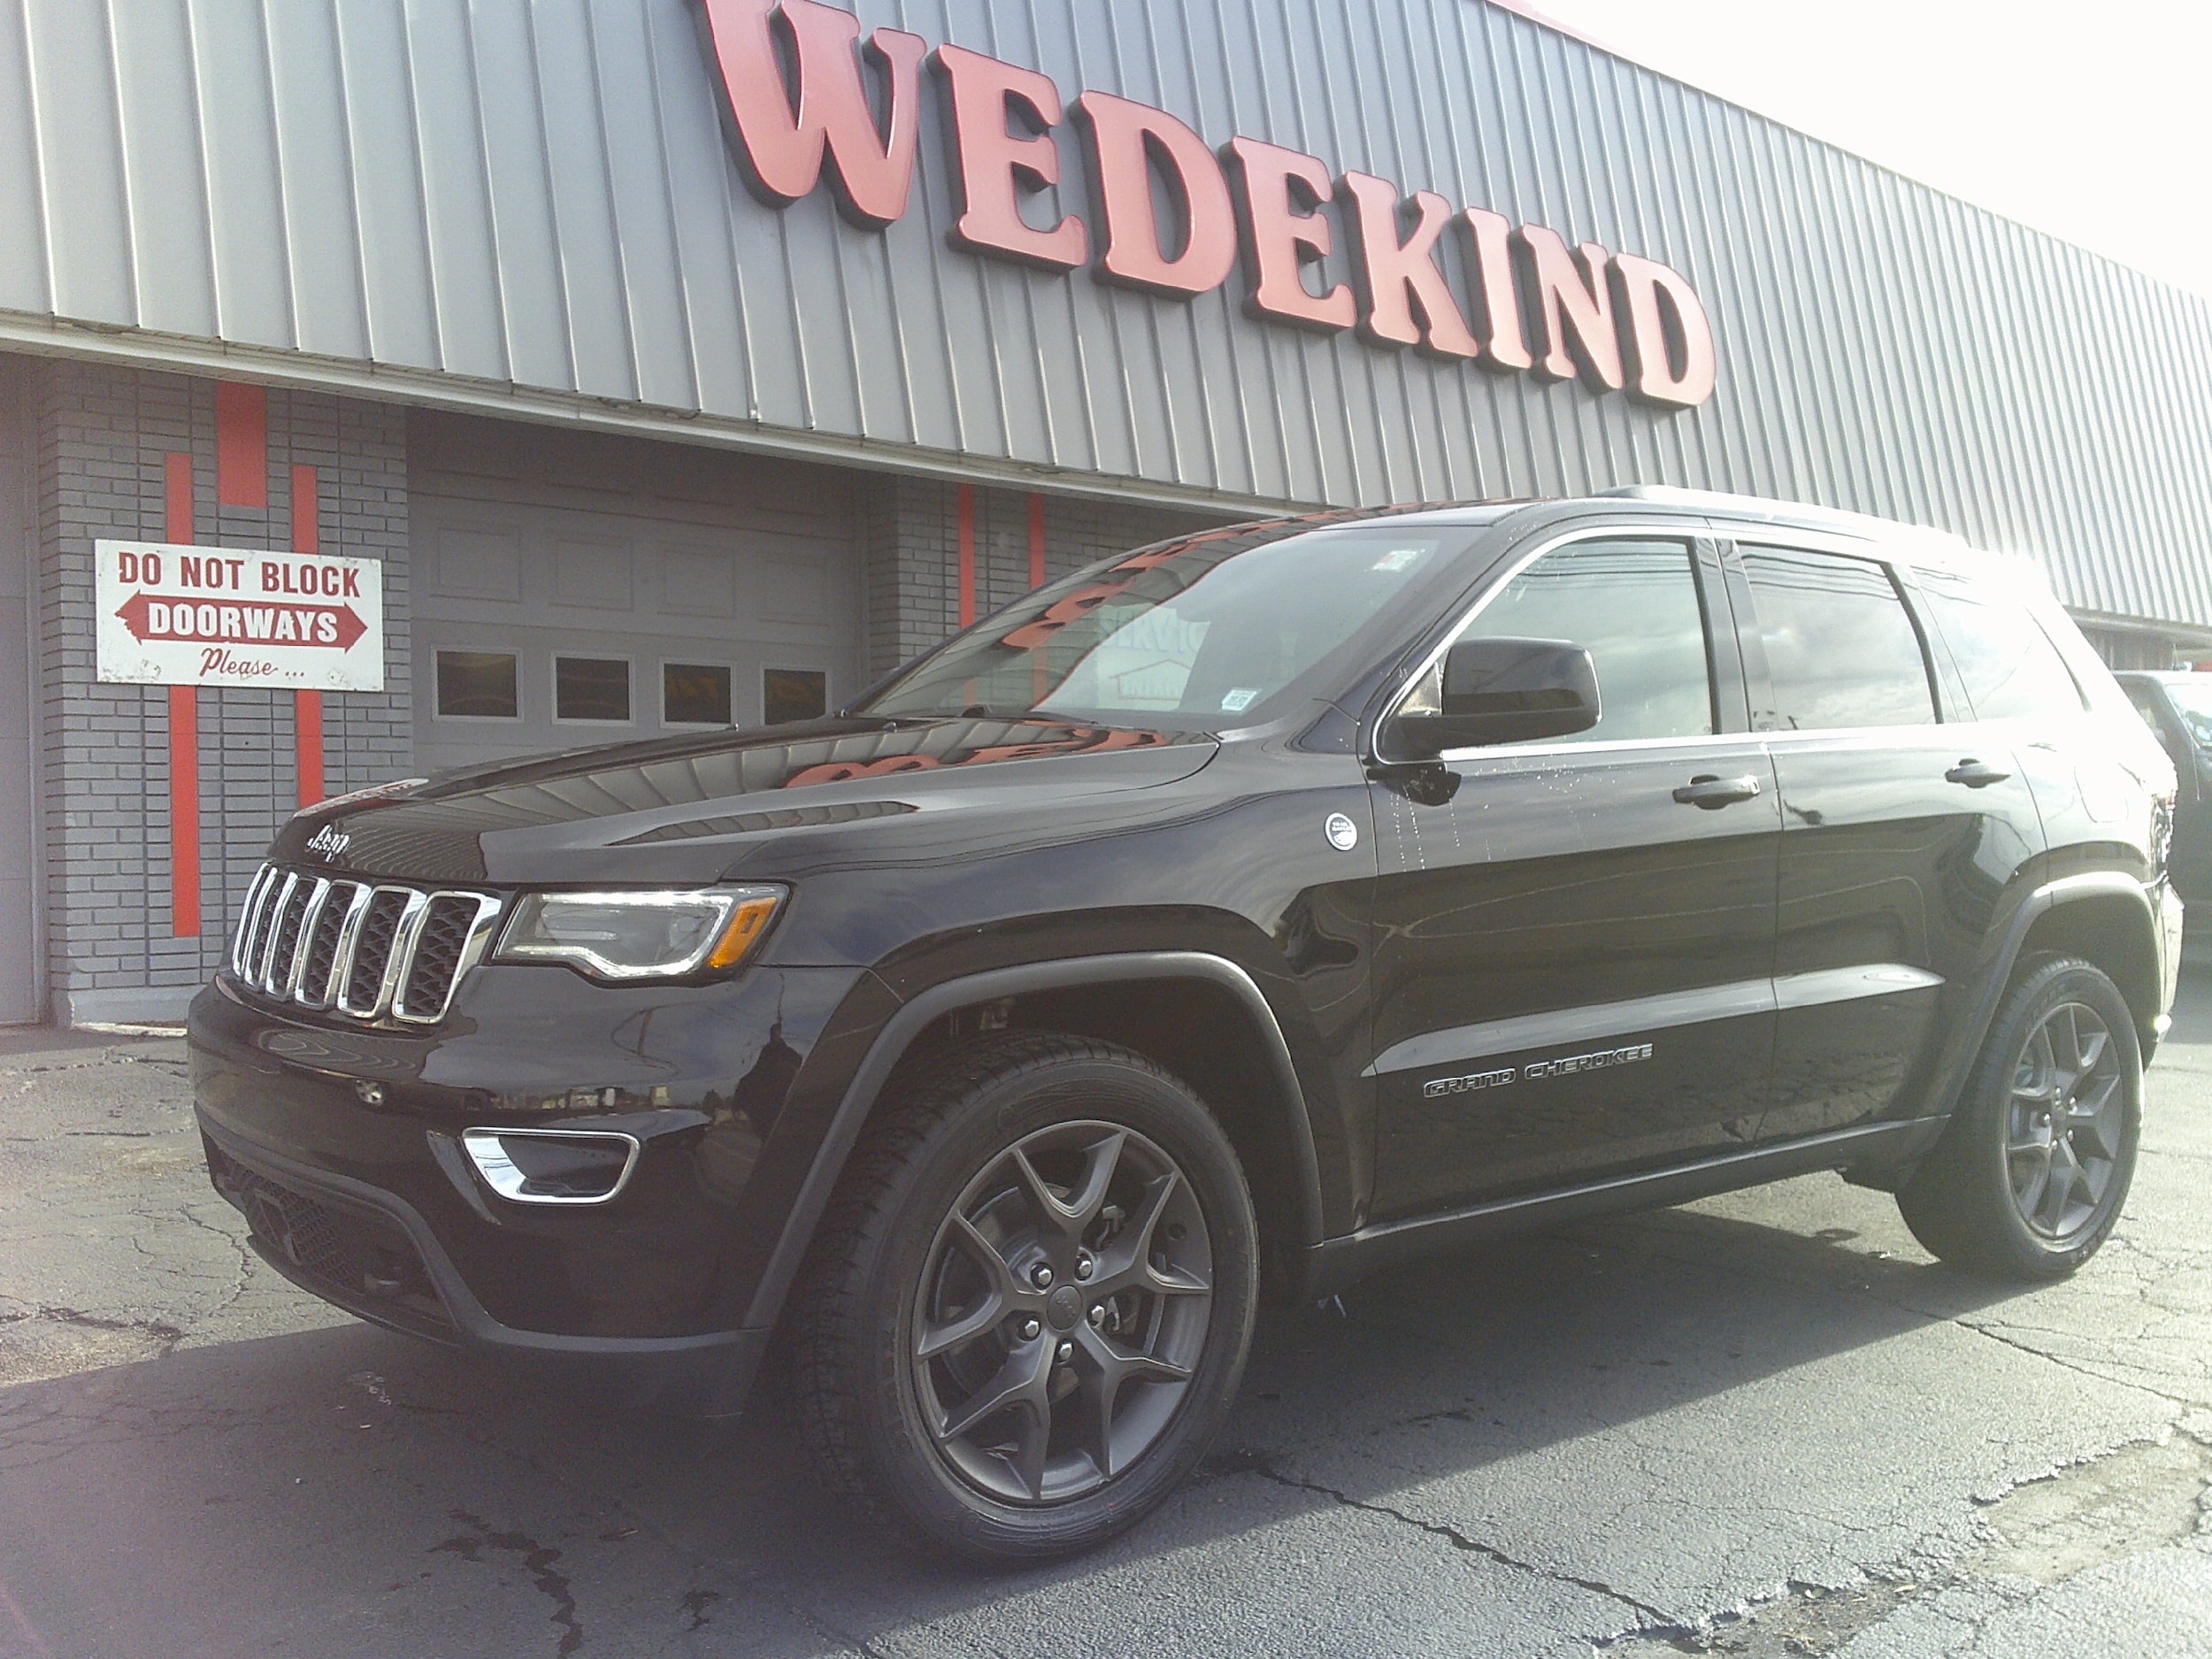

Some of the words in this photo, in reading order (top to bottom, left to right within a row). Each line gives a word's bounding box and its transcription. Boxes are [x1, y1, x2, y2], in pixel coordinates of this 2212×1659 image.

[700, 0, 1717, 410] WEDEKIND
[119, 551, 162, 585] DO
[180, 556, 245, 590] NOT
[262, 561, 361, 597] BLOCK
[148, 602, 339, 643] DOORWAYS
[1424, 1067, 1516, 1098] GRAND
[1525, 1043, 1654, 1080] CHEROKEE
